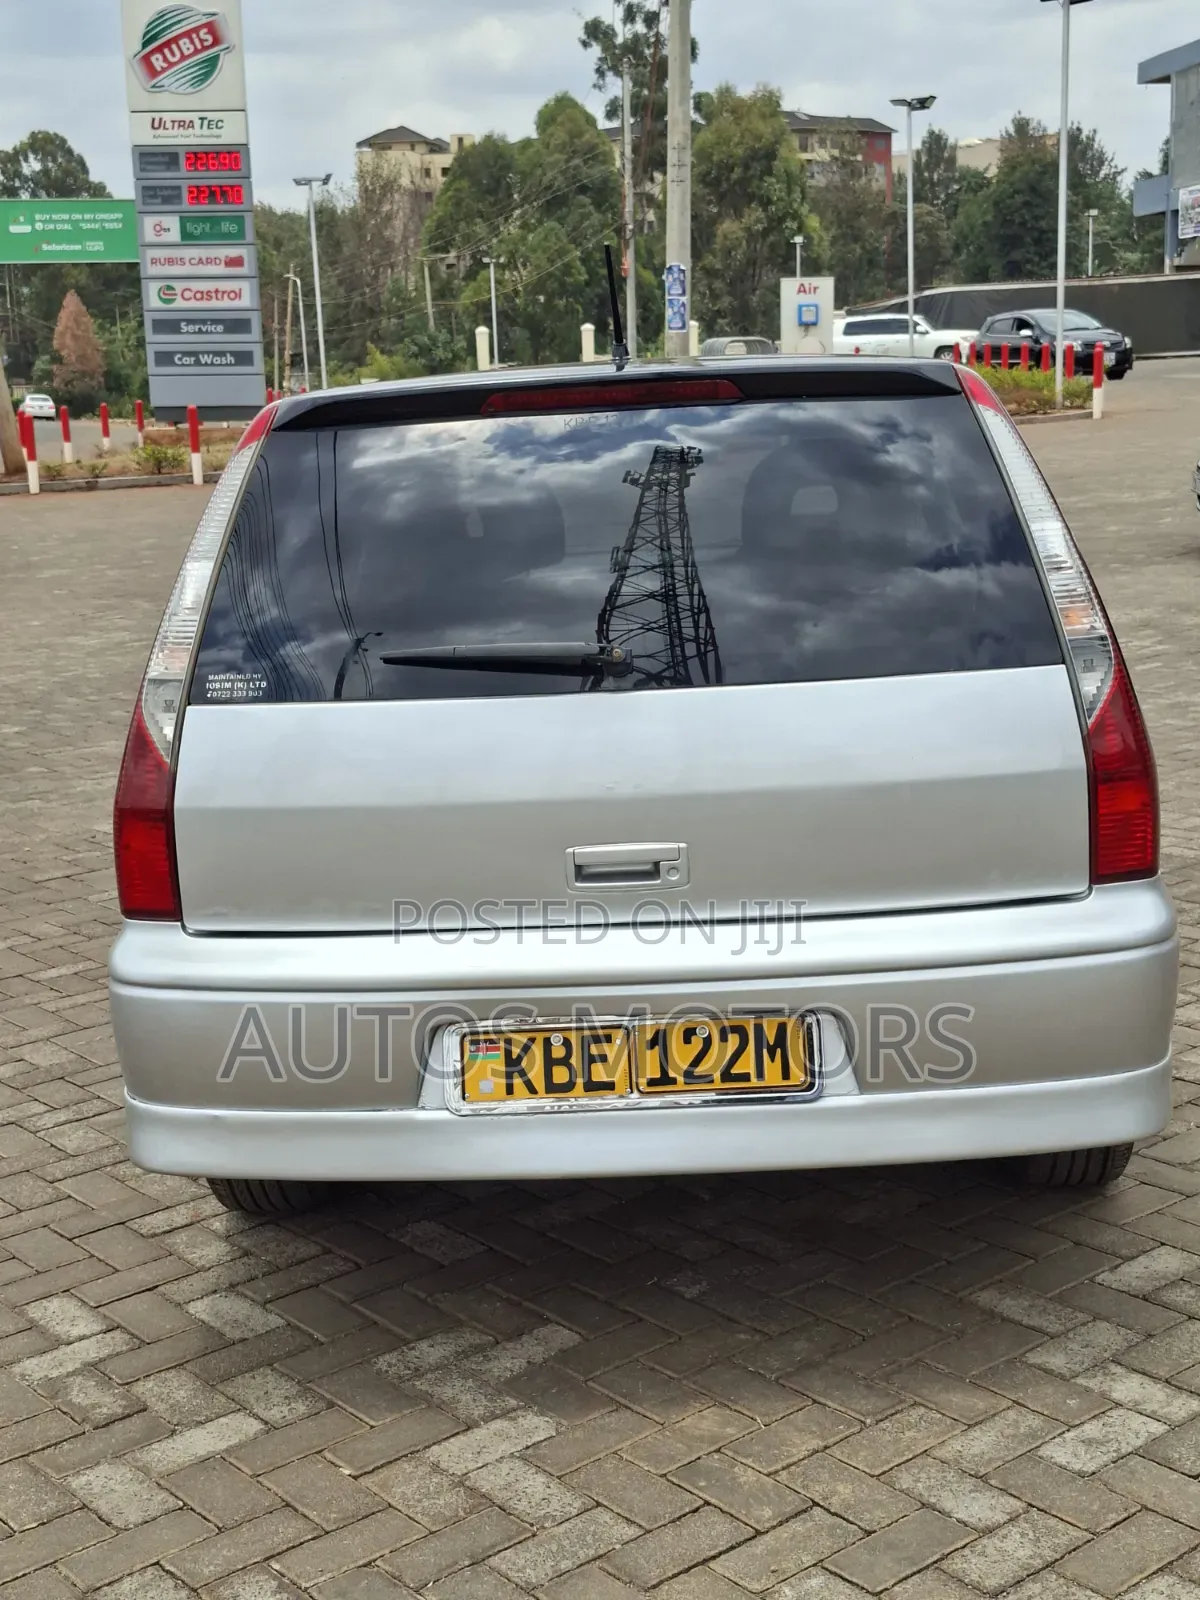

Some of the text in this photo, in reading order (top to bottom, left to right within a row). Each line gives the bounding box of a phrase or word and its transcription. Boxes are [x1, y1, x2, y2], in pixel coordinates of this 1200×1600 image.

[198, 117, 224, 130] TEC
[189, 257, 222, 266] CARD
[180, 287, 242, 301] Castrol
[796, 283, 820, 295] Air
[180, 321, 224, 333] Service
[174, 353, 235, 365] Car Wash
[503, 1021, 791, 1096] KBE 122M
